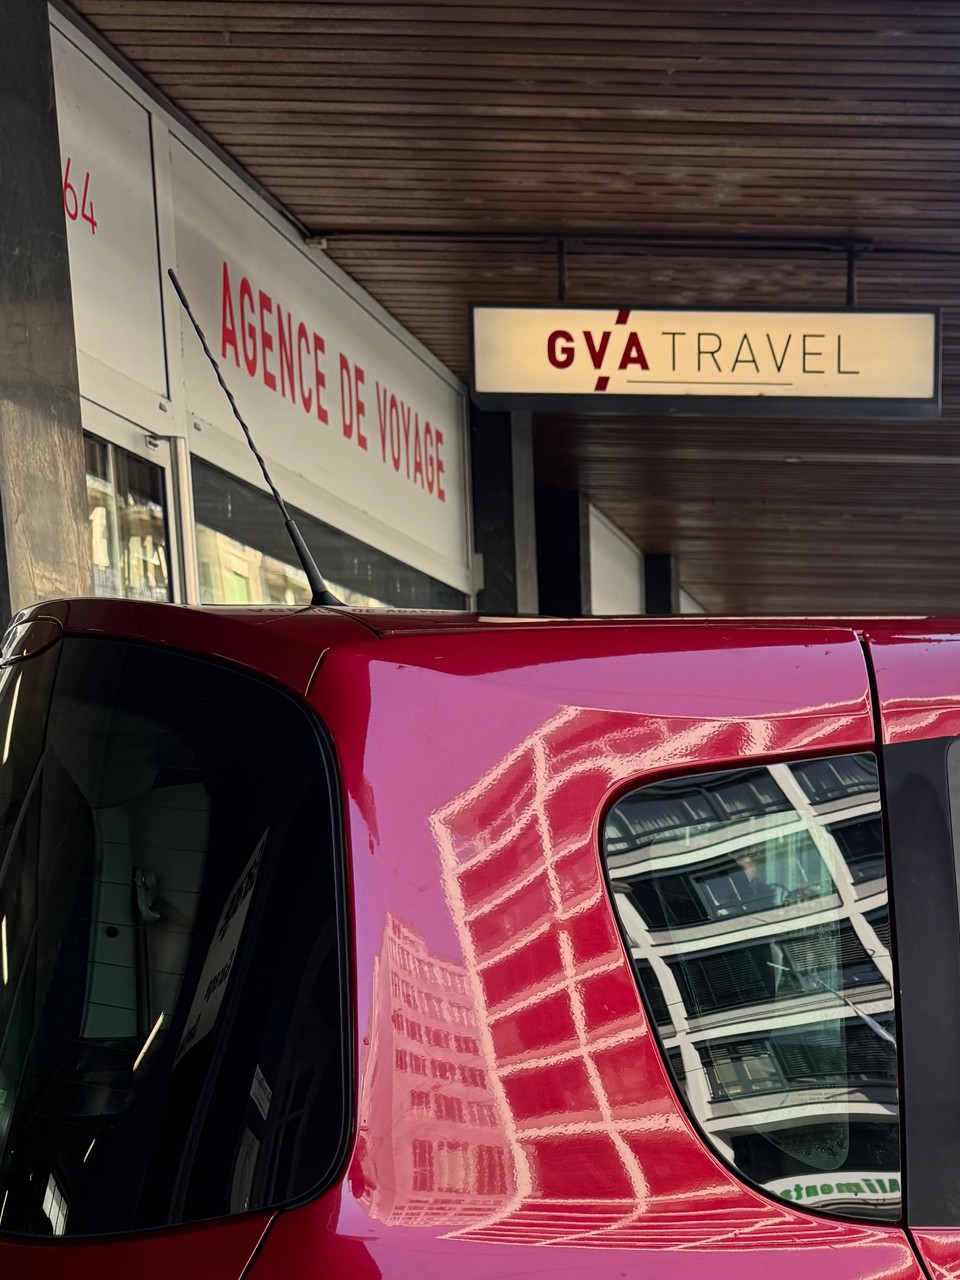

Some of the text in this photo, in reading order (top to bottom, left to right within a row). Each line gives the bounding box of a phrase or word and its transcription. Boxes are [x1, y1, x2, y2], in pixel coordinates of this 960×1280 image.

[63, 157, 98, 236] 64
[221, 260, 446, 503] AGENCE DE VOYAGE
[546, 326, 860, 374] GVA TRAVEL
